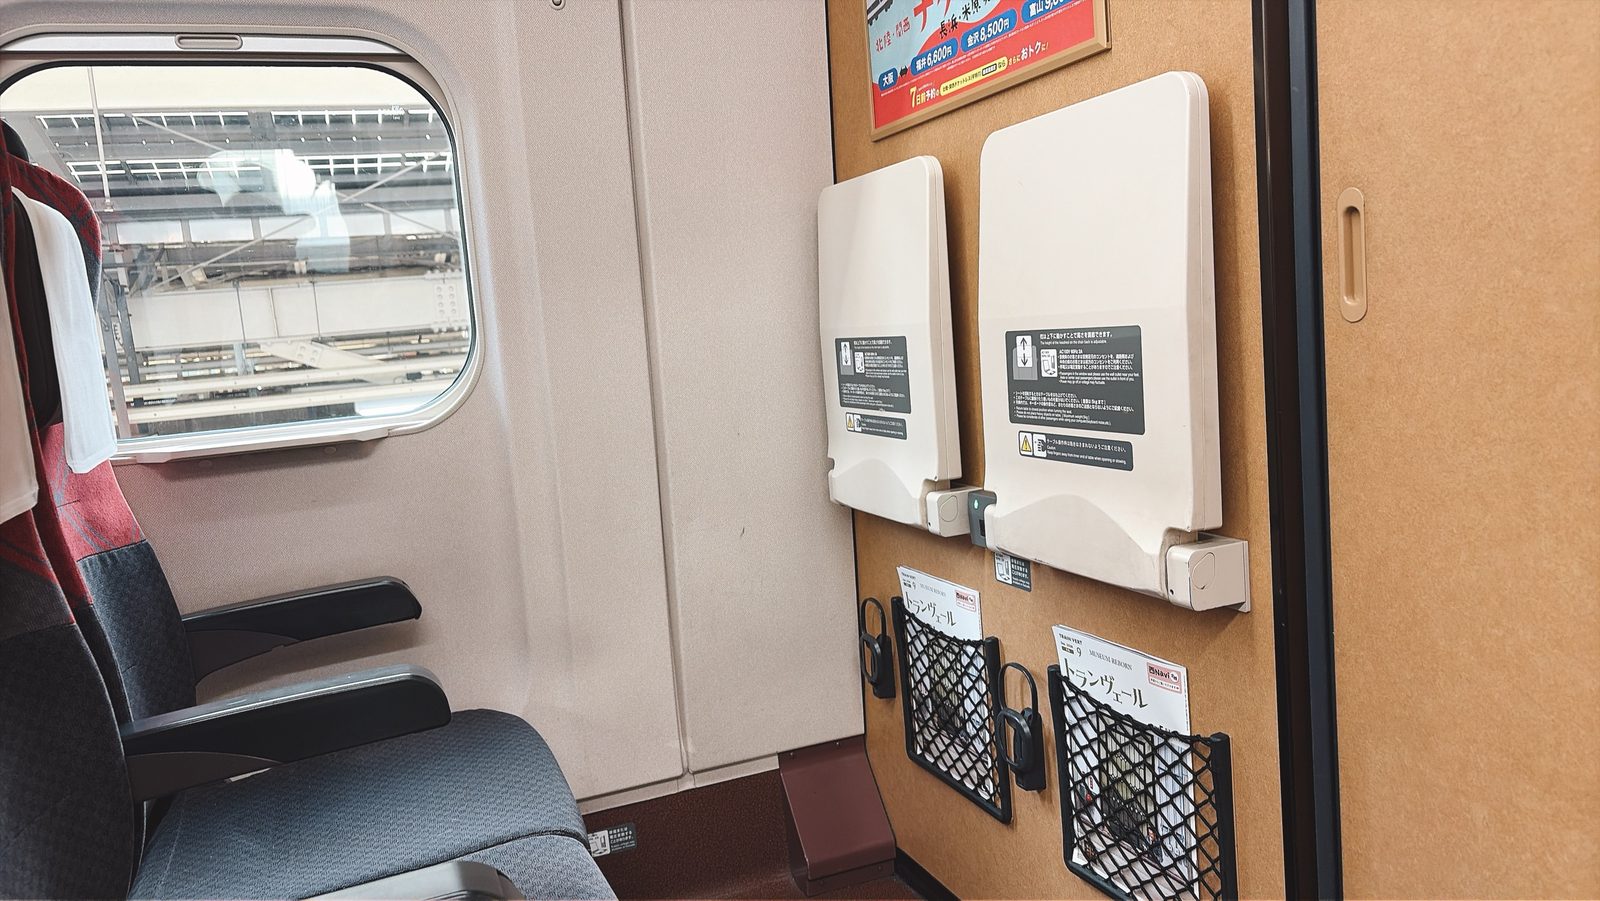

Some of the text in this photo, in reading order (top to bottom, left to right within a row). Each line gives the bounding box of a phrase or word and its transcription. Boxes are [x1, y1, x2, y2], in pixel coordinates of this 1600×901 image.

[882, 72, 894, 86] 大阪
[906, 592, 956, 626] トランヴェール
[1077, 647, 1082, 657] 9
[1064, 658, 1148, 708] トランヴェール
